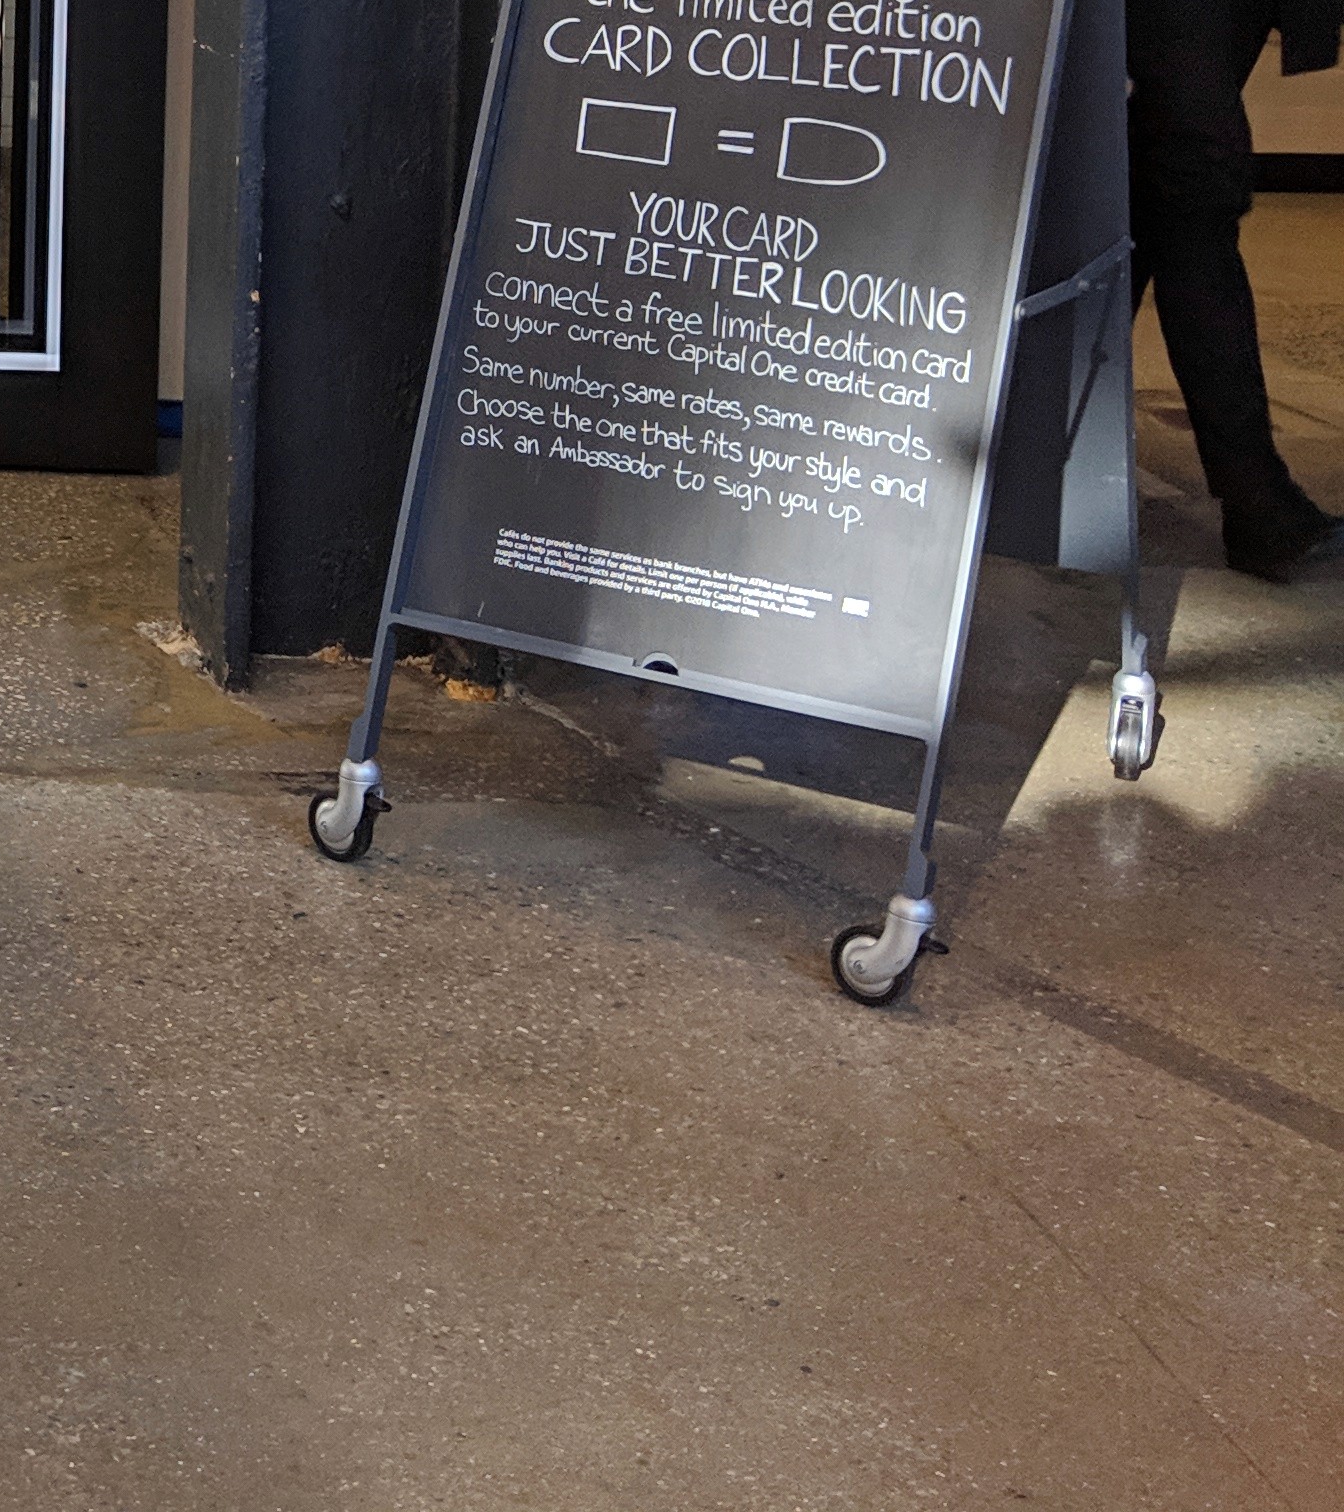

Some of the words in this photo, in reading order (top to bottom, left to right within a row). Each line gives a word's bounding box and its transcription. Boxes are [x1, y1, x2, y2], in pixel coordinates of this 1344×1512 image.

[543, 18, 673, 78] CARD
[687, 28, 1013, 115] COLLECTION
[629, 191, 720, 247] YOUR
[722, 205, 819, 262] CARD
[515, 217, 616, 266] JUST
[624, 237, 784, 305] BETTER
[791, 267, 966, 335] LOOKING
[473, 299, 500, 328] to
[504, 314, 560, 343] your
[567, 323, 660, 355] current
[667, 333, 747, 375] Capital
[750, 350, 799, 383] One
[804, 366, 875, 399] credit
[615, 299, 633, 322] a
[640, 291, 703, 336] free
[712, 301, 812, 355] limited
[813, 330, 907, 373] edition
[462, 345, 524, 385] Same
[529, 365, 620, 408] number,
[681, 388, 751, 431] rates,
[457, 389, 546, 426] Choose
[551, 402, 592, 433] the
[595, 419, 637, 442] one
[640, 420, 696, 455] that
[699, 429, 743, 463] fits
[748, 445, 801, 479] your
[805, 451, 862, 493] style
[870, 473, 927, 508] and
[460, 424, 504, 450] ask
[514, 435, 539, 455] an
[549, 436, 666, 479] Ambassador
[673, 460, 705, 491] to
[779, 490, 818, 518] you
[828, 502, 864, 534] up.
